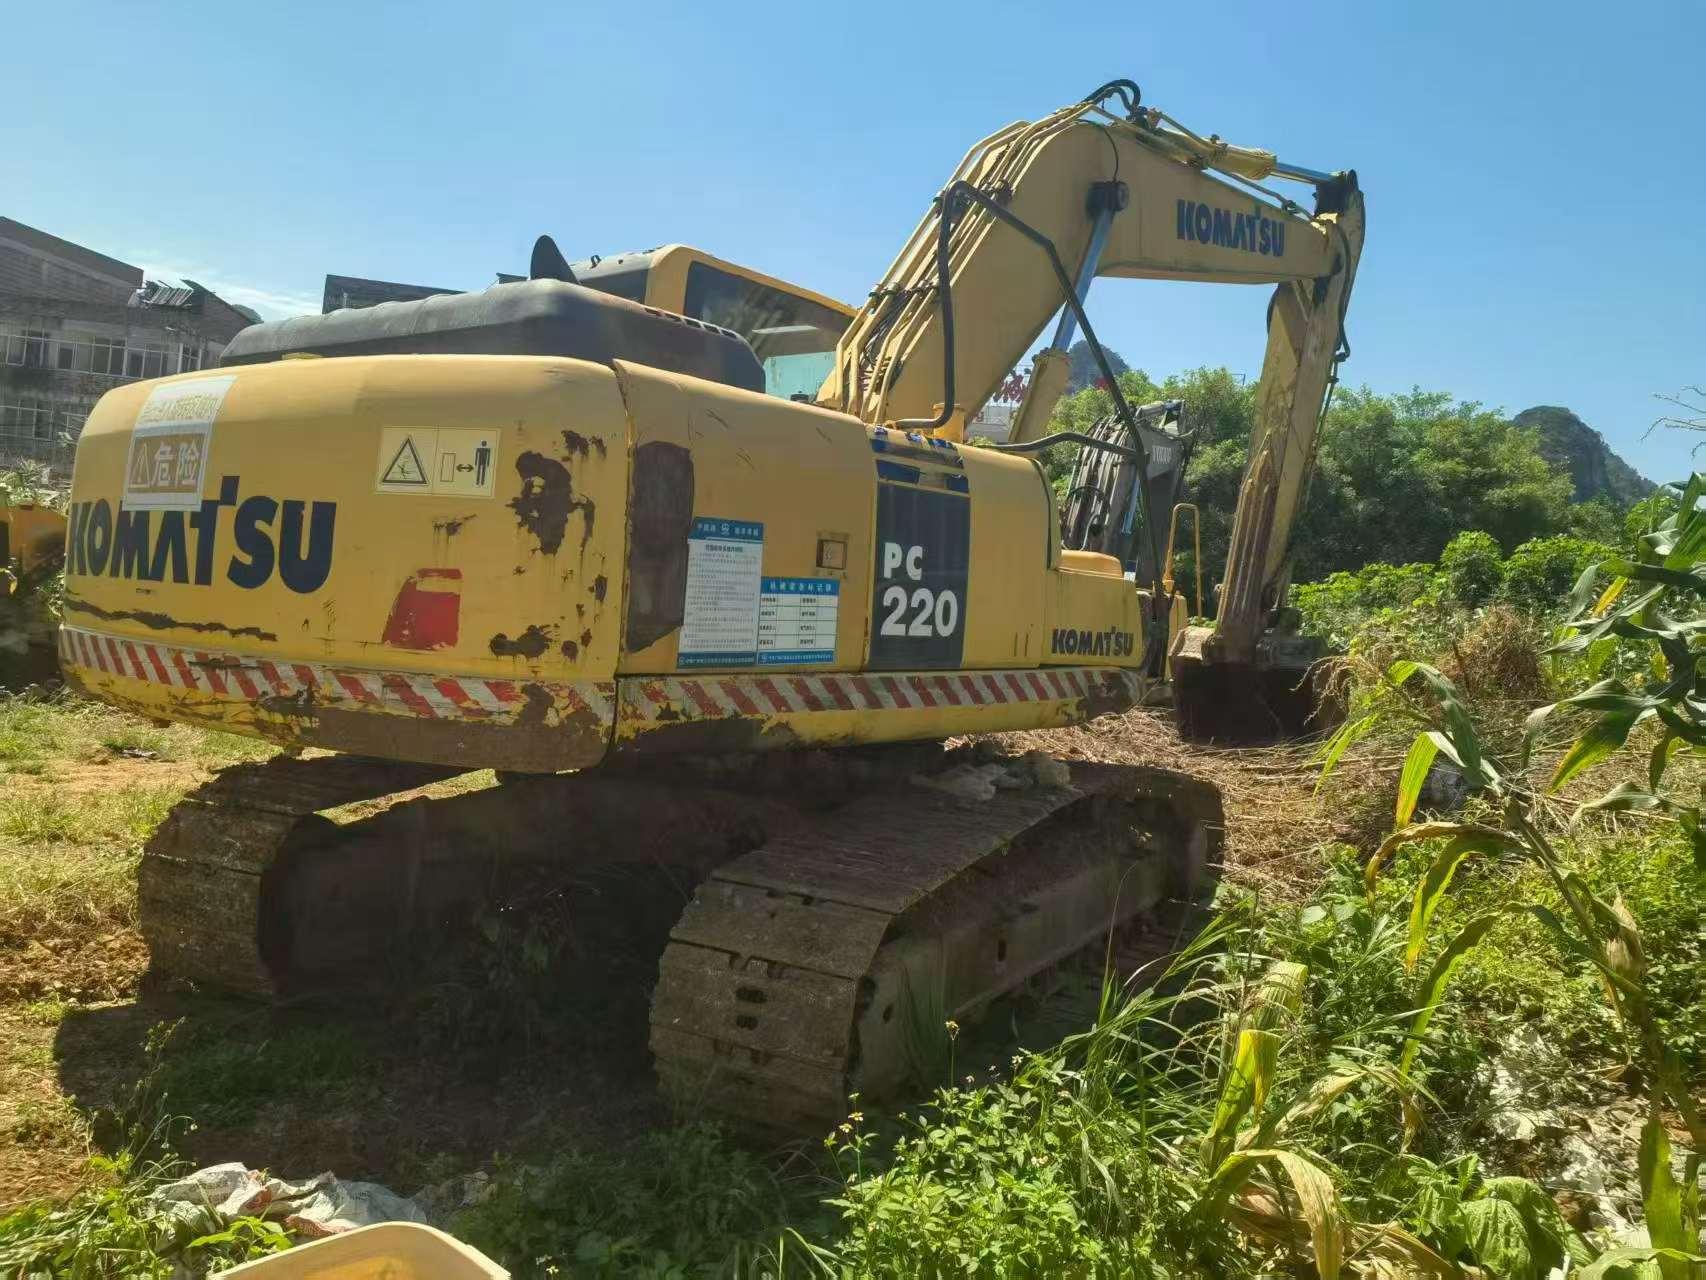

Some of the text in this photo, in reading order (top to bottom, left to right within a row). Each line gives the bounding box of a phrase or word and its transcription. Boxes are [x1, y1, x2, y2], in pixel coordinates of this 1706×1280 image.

[1177, 199, 1285, 257] KOMATSU
[152, 442, 199, 488] 危险
[66, 475, 337, 594] KOMATSU
[883, 542, 924, 581] PC
[880, 586, 958, 638] 220
[1052, 625, 1134, 657] KOMATSU
